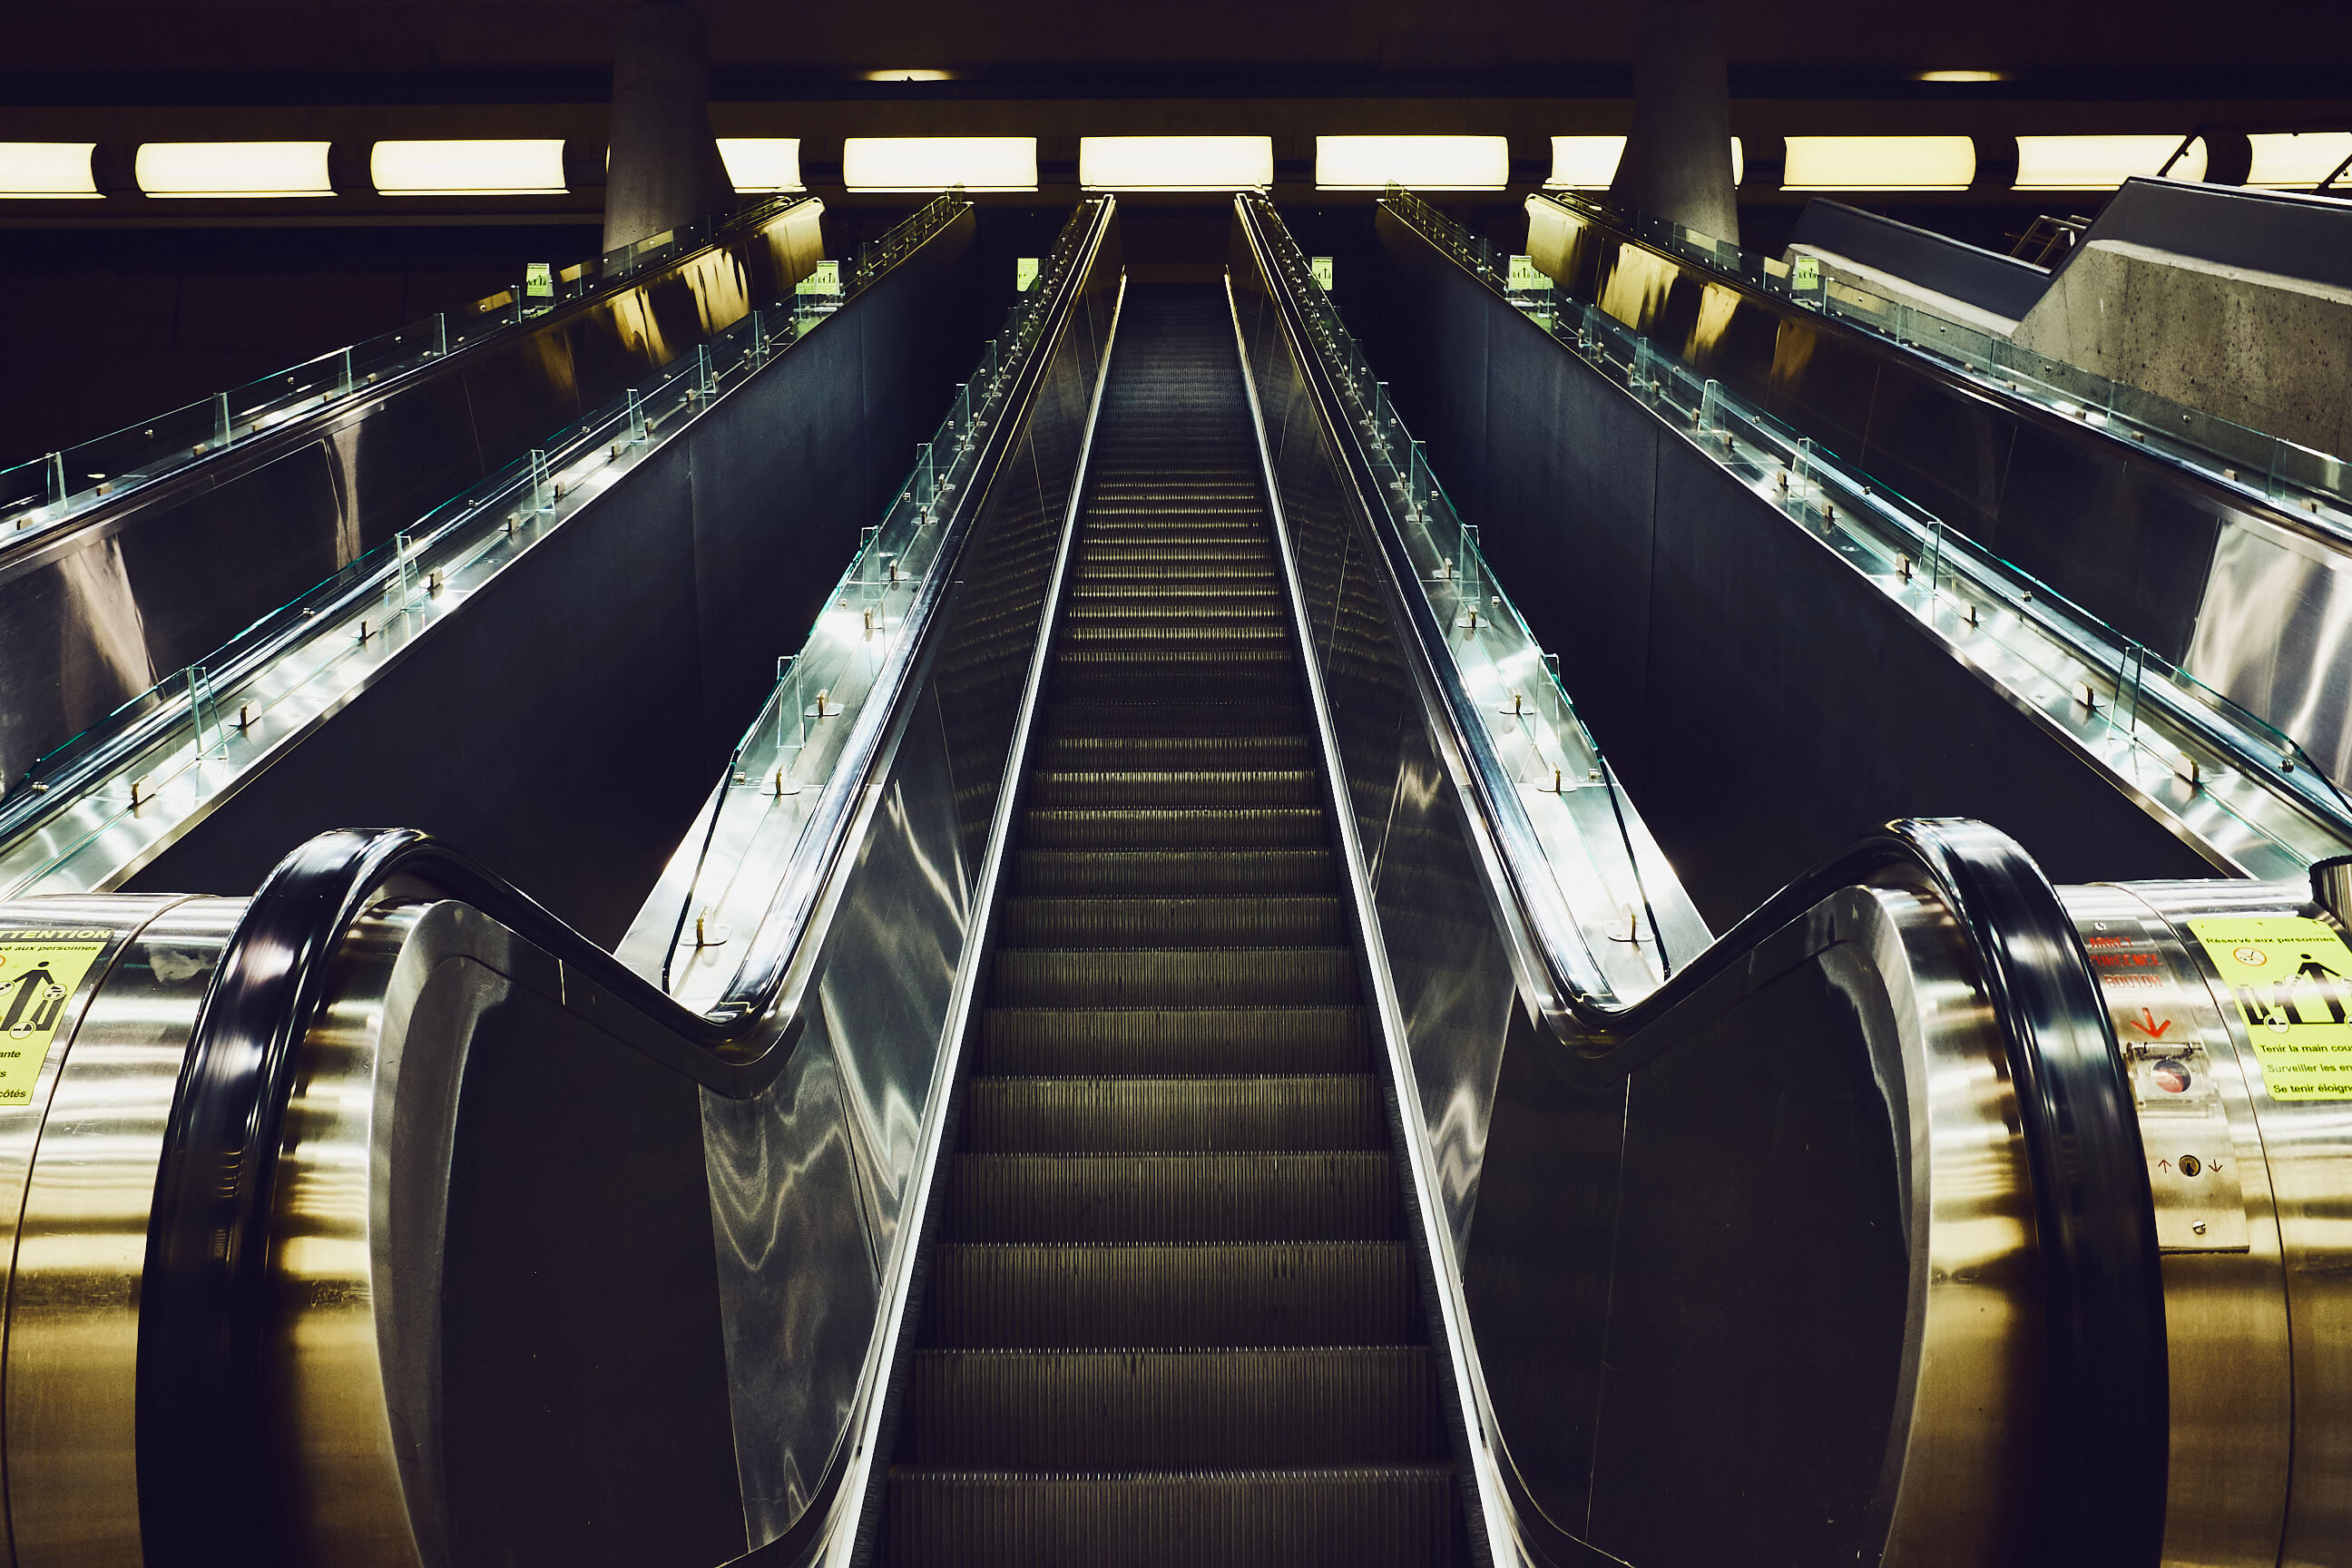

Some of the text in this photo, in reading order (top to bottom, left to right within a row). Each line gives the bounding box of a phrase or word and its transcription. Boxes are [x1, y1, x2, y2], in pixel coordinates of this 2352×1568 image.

[2103, 974, 2162, 988] BOUTON
[2259, 1044, 2286, 1053] Tenir
[2288, 1044, 2299, 1053] la
[2301, 1044, 2328, 1053] main
[2267, 1063, 2318, 1073] Surveiller
[2320, 1063, 2337, 1072] les
[2273, 1083, 2352, 1094] Se tenir éloign
